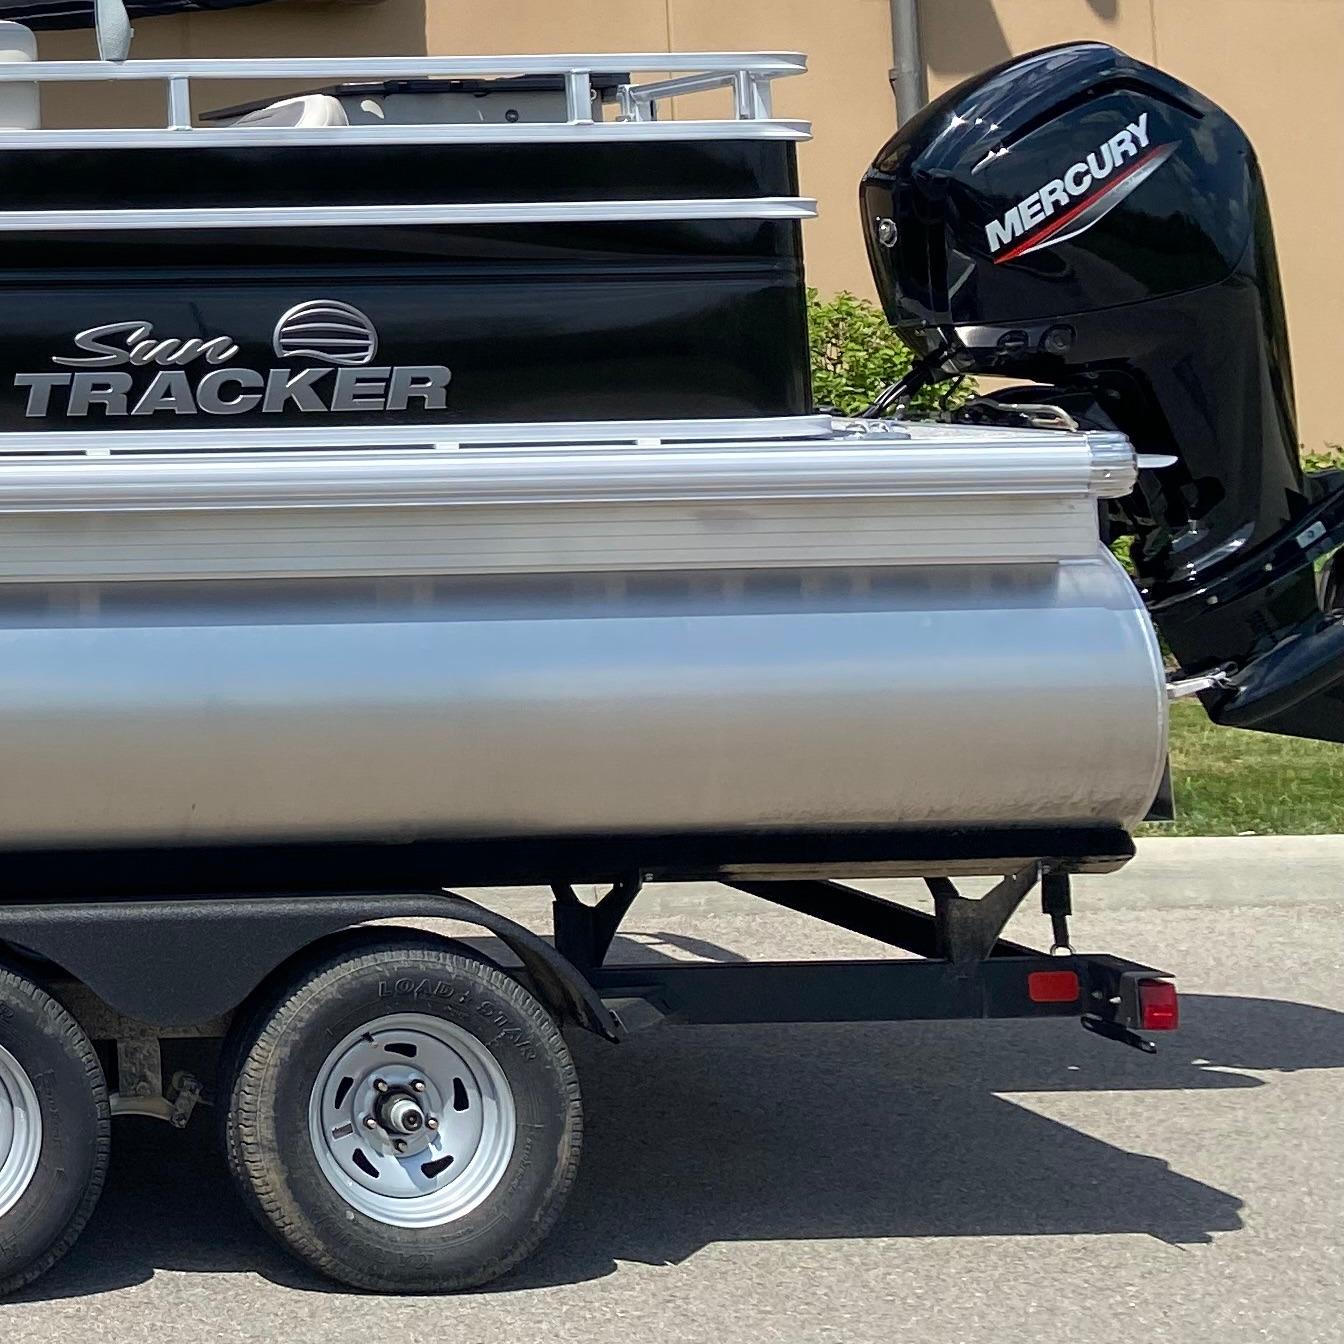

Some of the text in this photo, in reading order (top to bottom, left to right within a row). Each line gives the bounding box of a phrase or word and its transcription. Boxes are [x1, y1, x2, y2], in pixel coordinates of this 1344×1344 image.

[985, 113, 1152, 253] MERCURY
[52, 320, 239, 367] Sun
[14, 365, 452, 417] TRACKER
